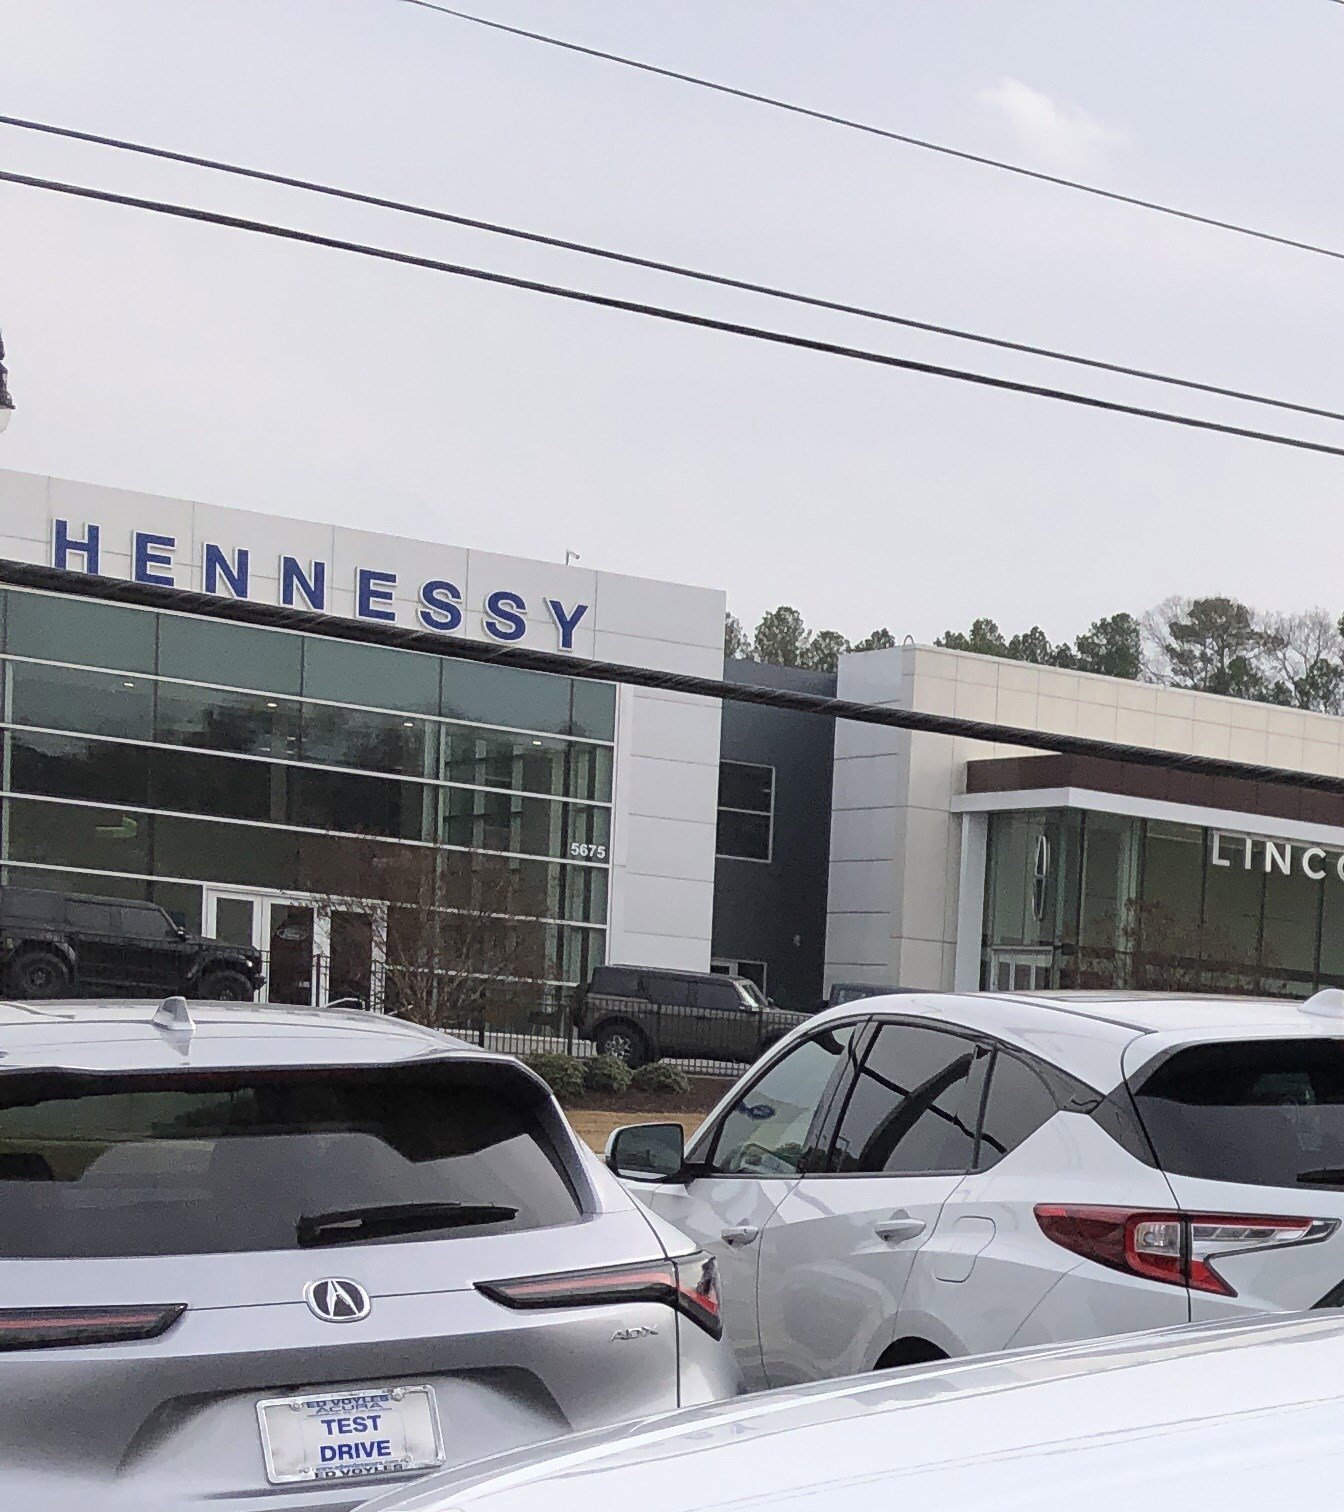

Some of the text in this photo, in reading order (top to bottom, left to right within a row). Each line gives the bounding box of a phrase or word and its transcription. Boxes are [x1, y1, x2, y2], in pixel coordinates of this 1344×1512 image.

[53, 519, 589, 650] HENNESSY
[570, 842, 606, 859] 5675
[315, 1403, 383, 1414] ACURA
[321, 1415, 382, 1436] TEST
[320, 1440, 392, 1462] DRIVE
